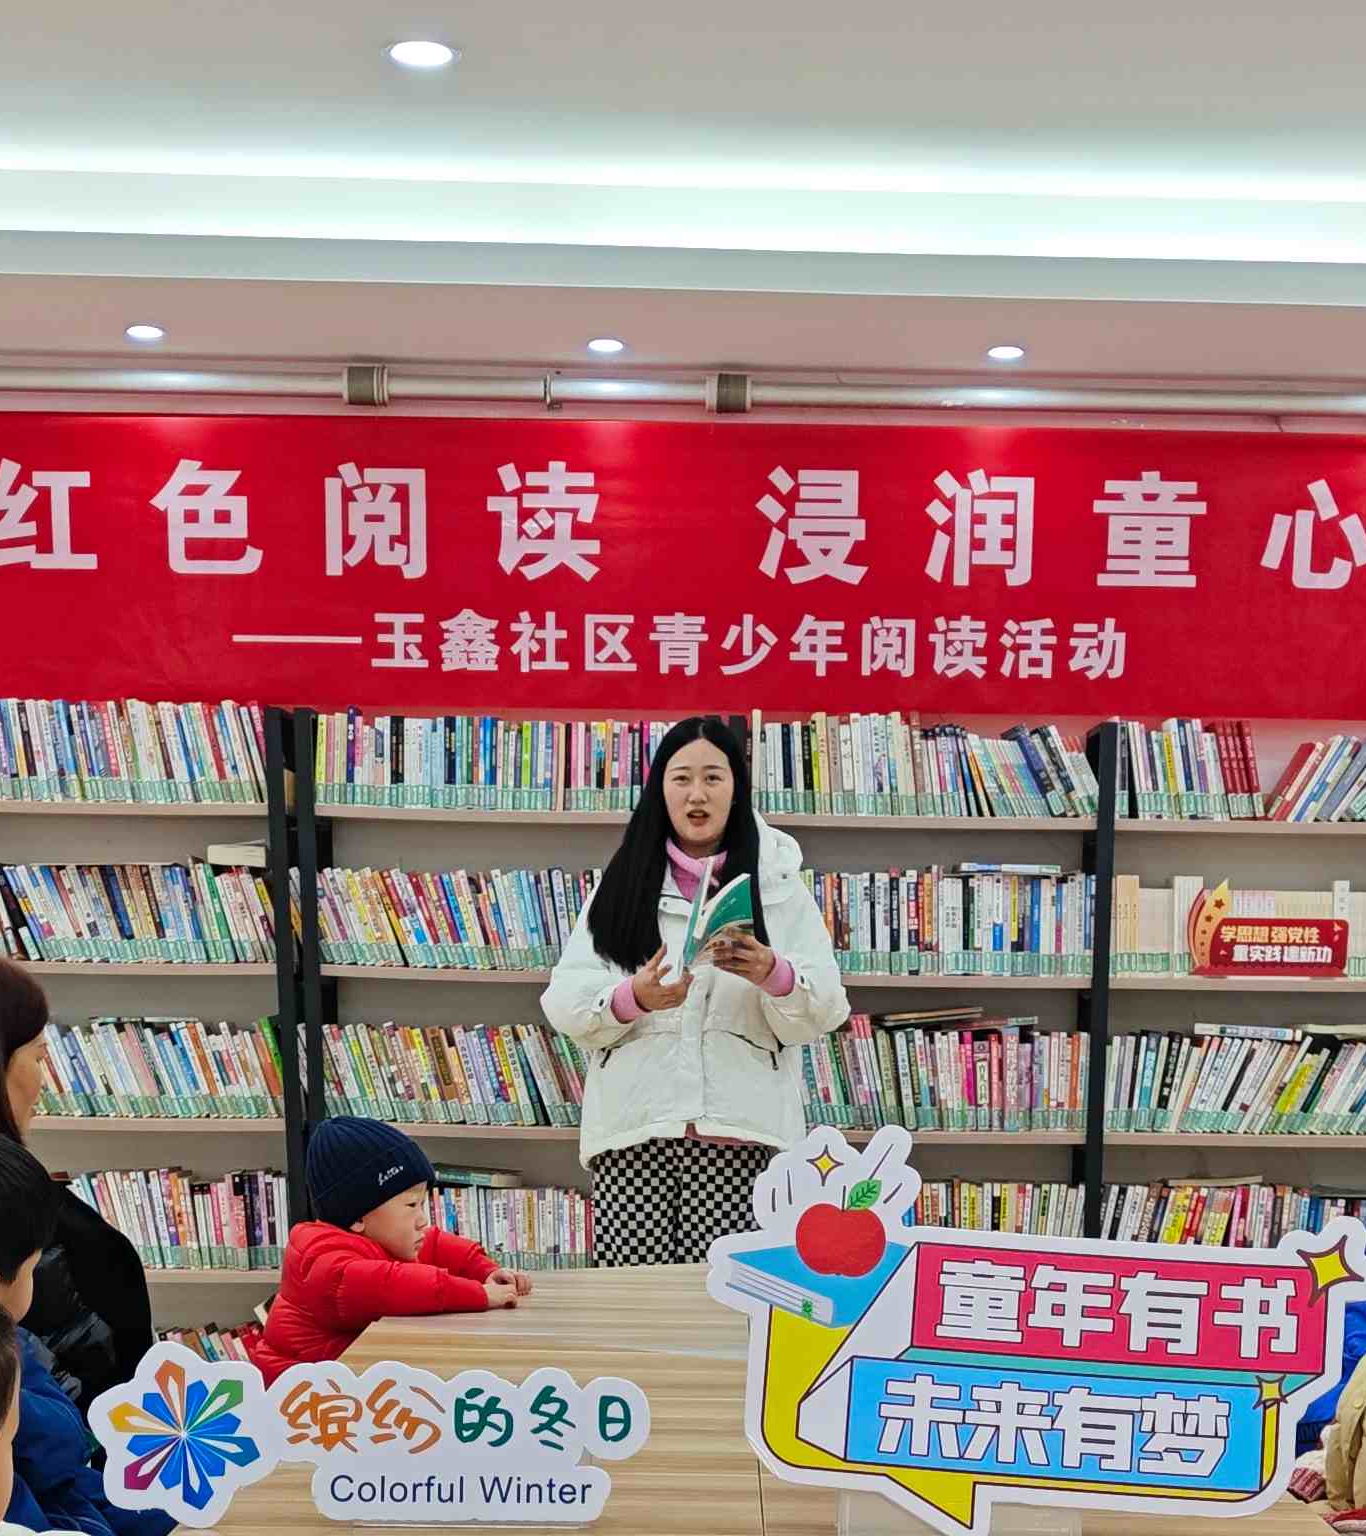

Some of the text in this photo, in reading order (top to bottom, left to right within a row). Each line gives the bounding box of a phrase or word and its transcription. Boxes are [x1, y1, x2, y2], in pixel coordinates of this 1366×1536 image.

[935, 1256, 1302, 1359] 童年有书
[280, 1379, 633, 1453] 缤纷的冬日
[876, 1375, 1231, 1478] 未来有梦
[330, 1474, 594, 1506] Colorful Winter
